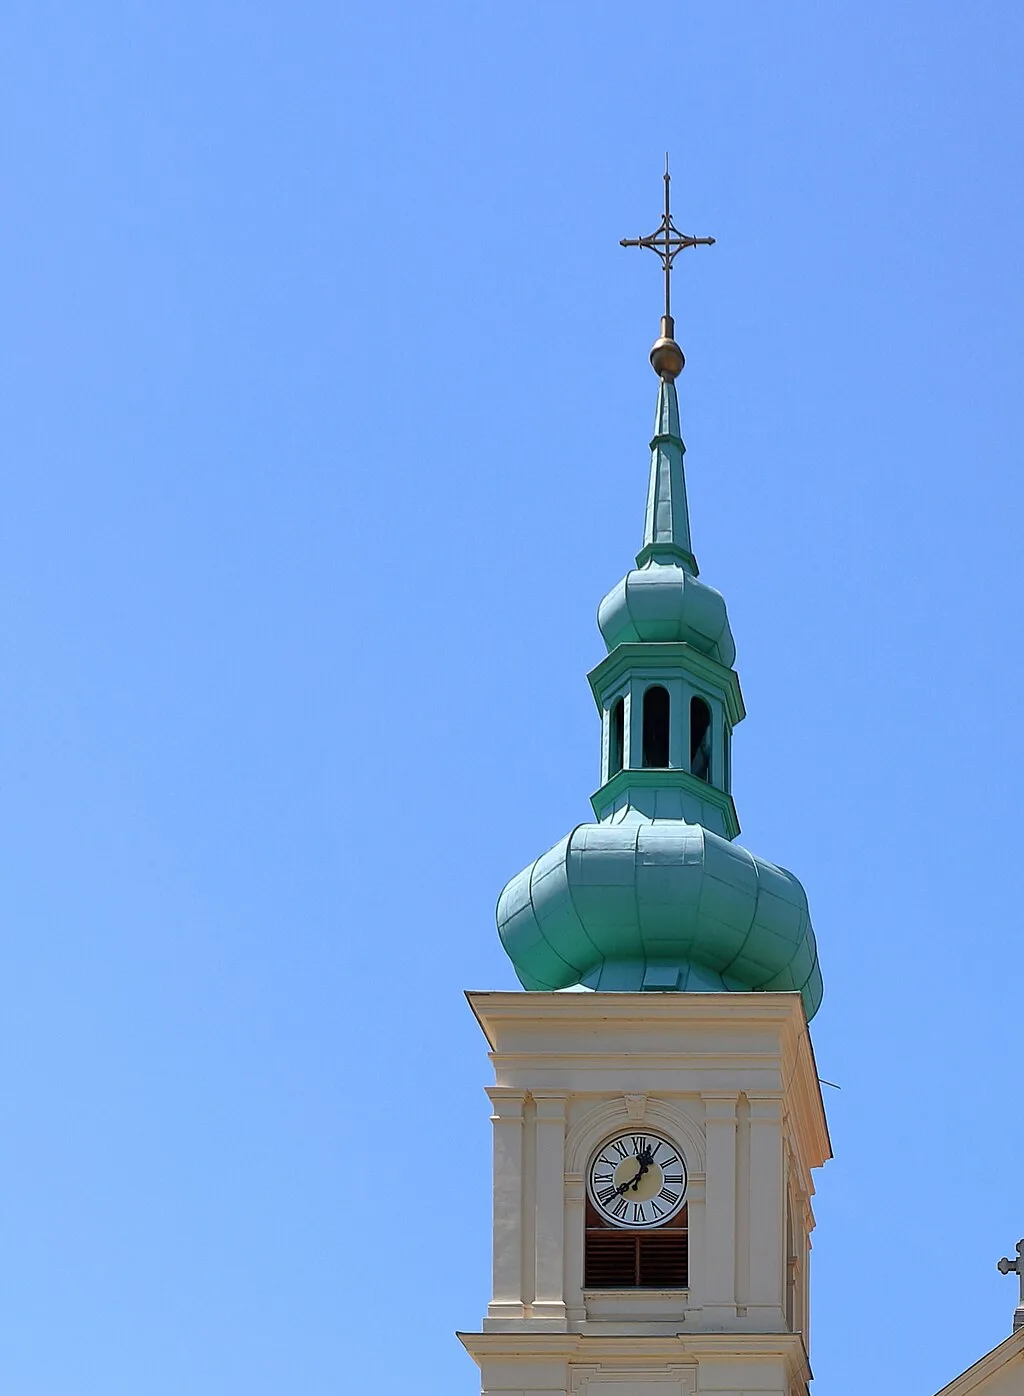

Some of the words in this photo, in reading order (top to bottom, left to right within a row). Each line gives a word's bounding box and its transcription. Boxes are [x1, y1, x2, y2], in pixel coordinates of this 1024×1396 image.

[611, 1141, 629, 1160] XI
[631, 1137, 646, 1155] XII
[650, 1142, 663, 1158] I
[598, 1155, 618, 1169] X
[660, 1155, 679, 1169] II
[594, 1173, 613, 1184] IX
[664, 1174, 683, 1184] III
[658, 1187, 679, 1205] IIII
[612, 1198, 629, 1219] VII
[633, 1204, 647, 1222] VI
[651, 1201, 665, 1218] V
